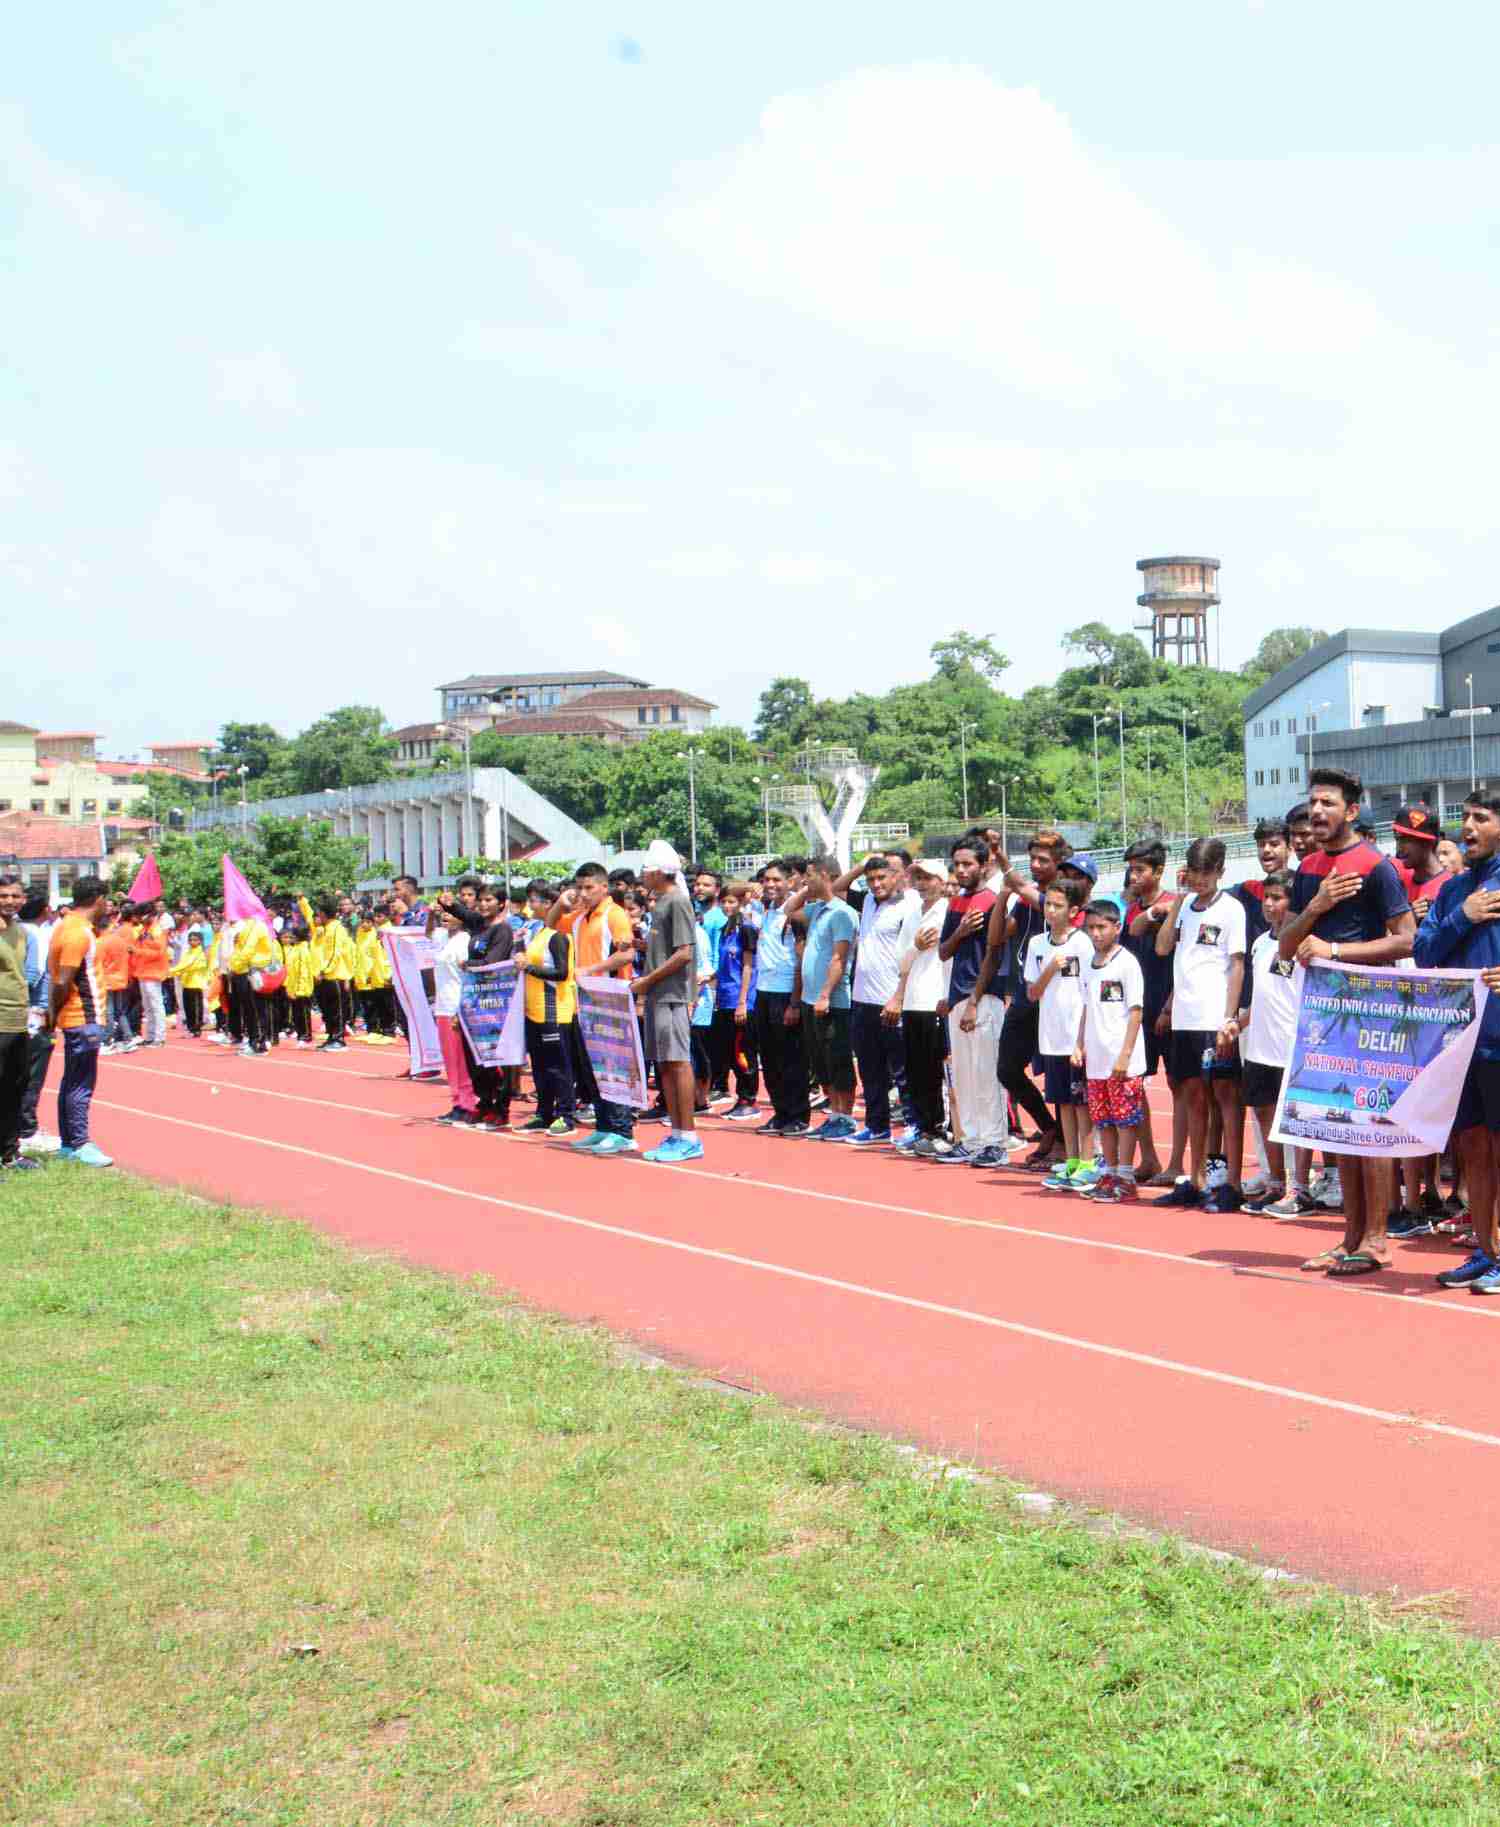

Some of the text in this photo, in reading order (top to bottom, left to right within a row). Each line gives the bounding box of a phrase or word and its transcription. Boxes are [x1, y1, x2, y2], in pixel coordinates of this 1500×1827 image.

[1304, 996, 1471, 1025] UNITED INDIA GAMES ASSOCIATION
[1359, 1028, 1406, 1053] DELHI
[1304, 1054, 1358, 1076] NATIONAL
[1355, 1087, 1391, 1111] GOA
